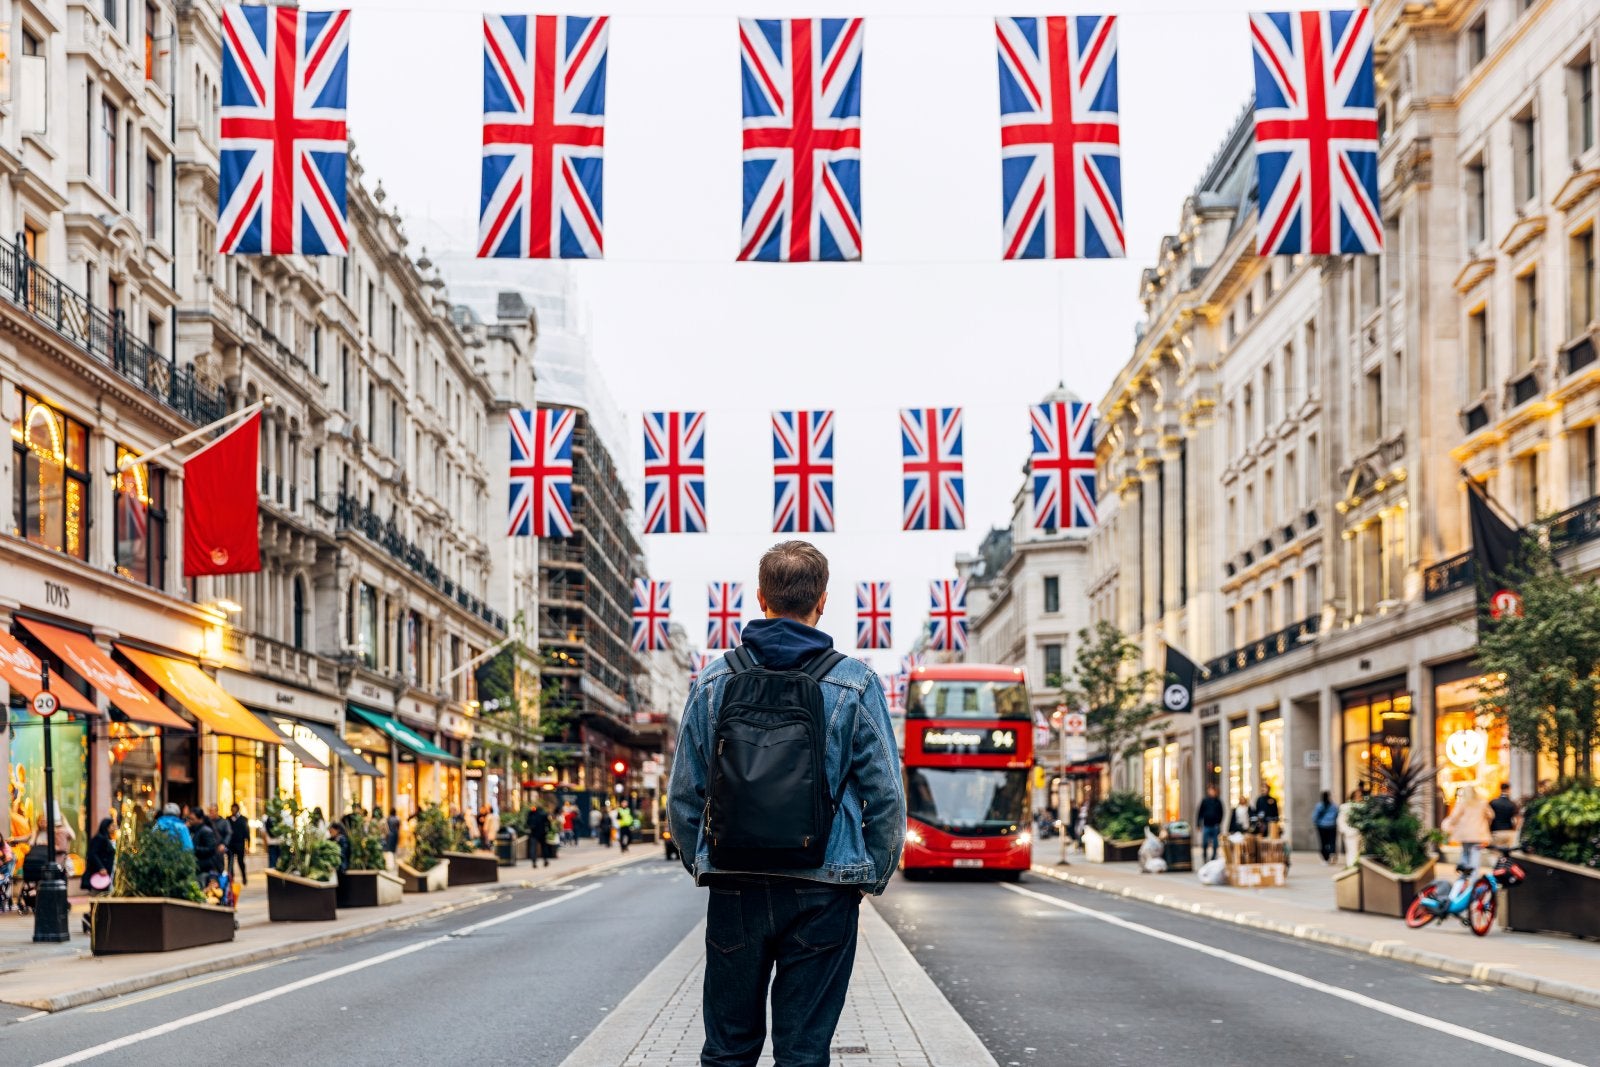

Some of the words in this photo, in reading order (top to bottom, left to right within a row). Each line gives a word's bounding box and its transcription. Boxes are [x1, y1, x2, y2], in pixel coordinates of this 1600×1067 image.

[44, 581, 69, 609] TOYS
[37, 698, 54, 708] 20
[992, 729, 1014, 748] 94
